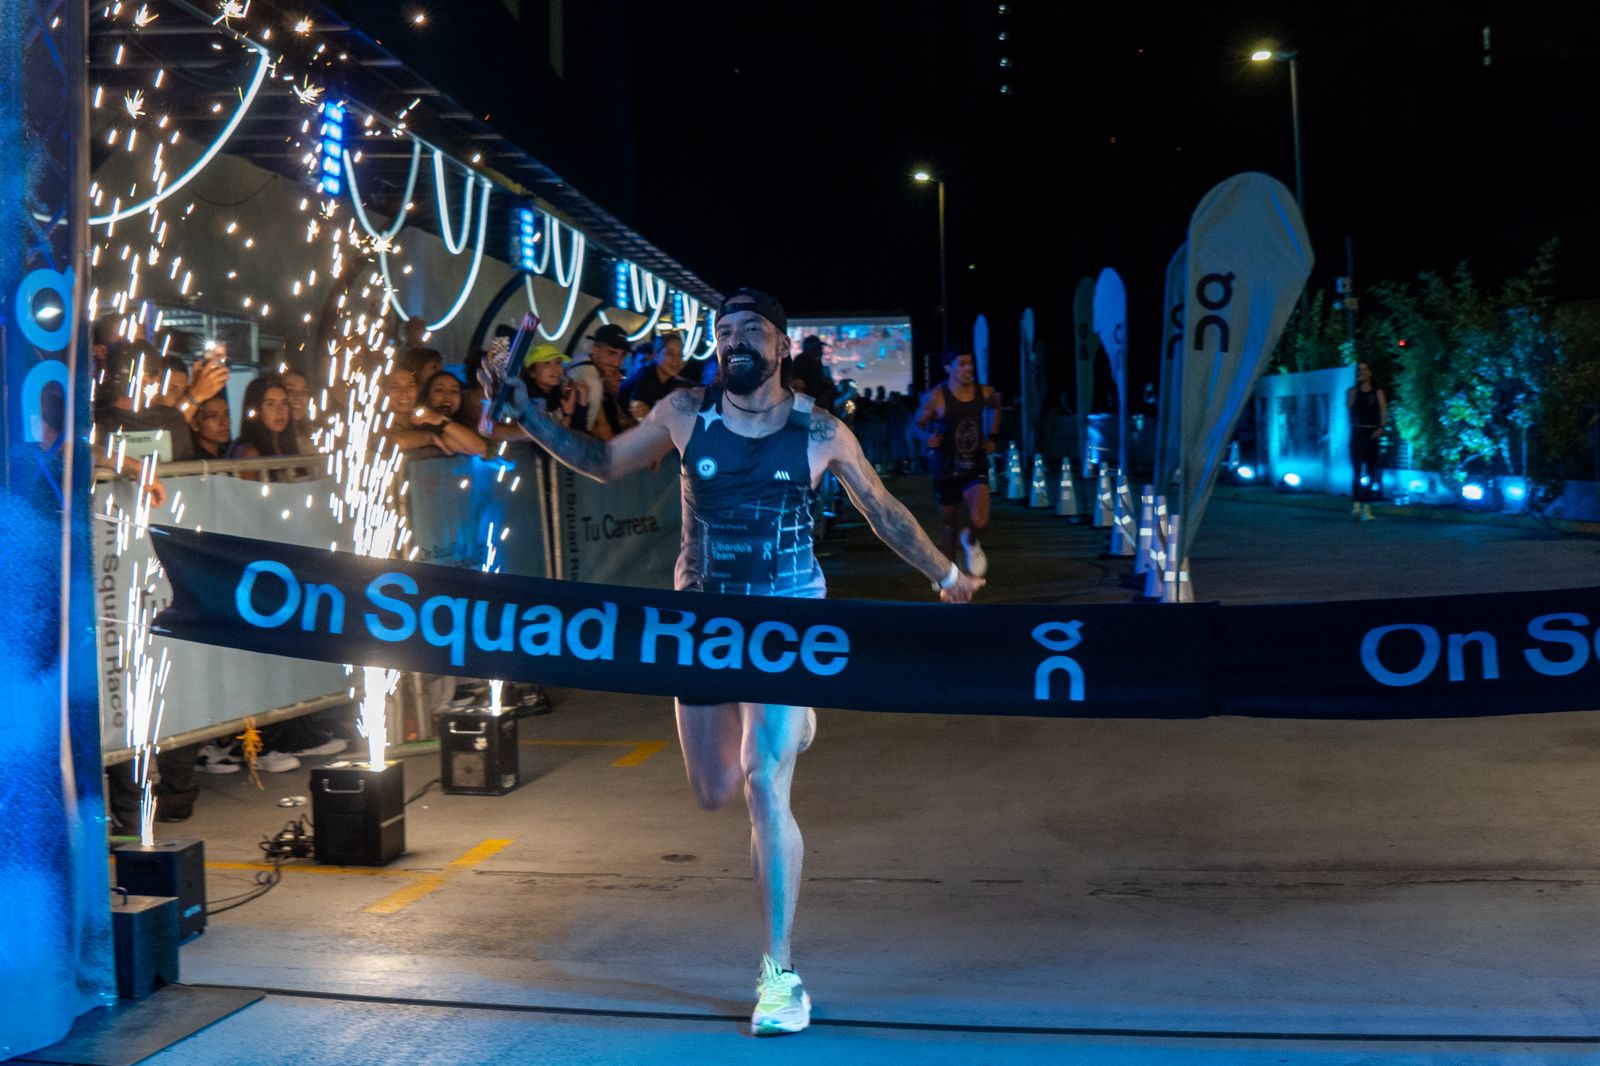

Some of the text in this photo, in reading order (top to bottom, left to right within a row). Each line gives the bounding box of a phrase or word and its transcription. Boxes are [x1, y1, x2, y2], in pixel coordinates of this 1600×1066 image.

[711, 551, 736, 560] Team
[98, 552, 120, 649] Squad
[235, 560, 850, 678] On Squad Race
[104, 655, 125, 729] Race
[1360, 623, 1500, 687] On
